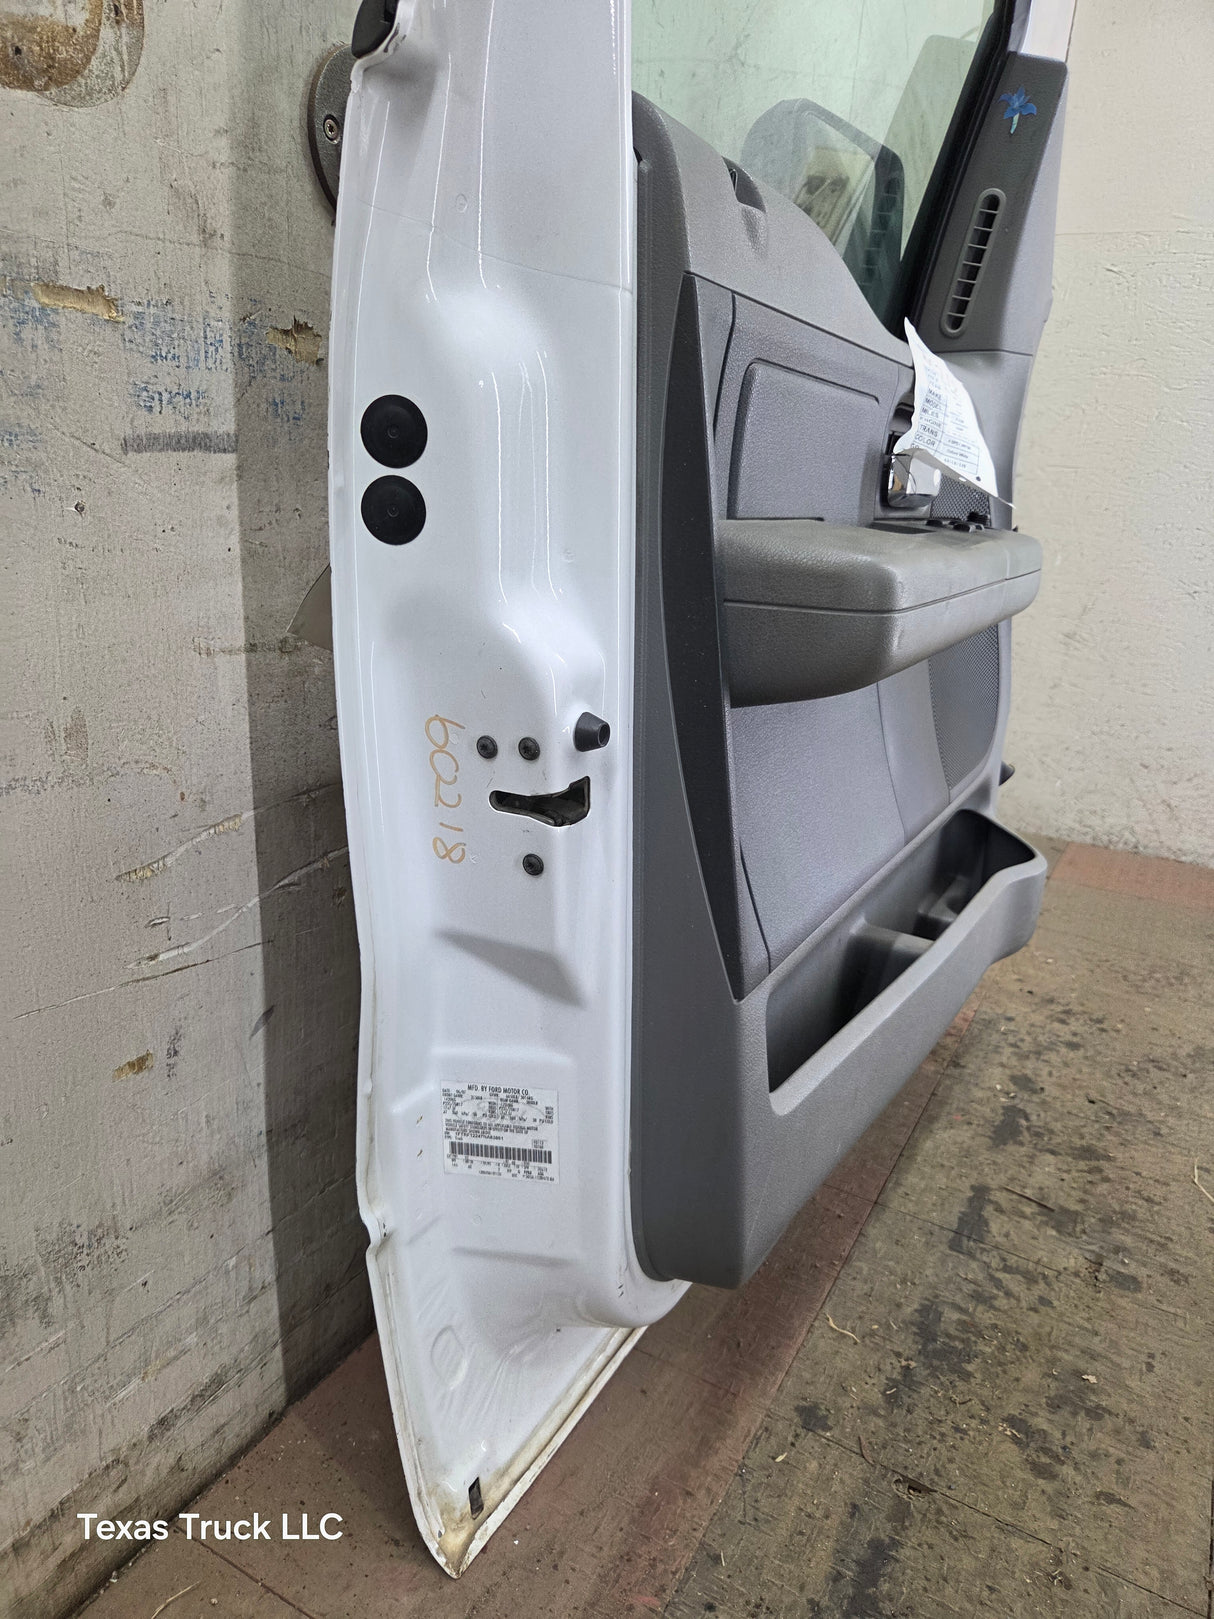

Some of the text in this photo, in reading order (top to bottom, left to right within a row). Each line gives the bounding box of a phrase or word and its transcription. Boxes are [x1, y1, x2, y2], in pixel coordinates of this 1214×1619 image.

[920, 424, 938, 438] TRANS
[914, 433, 936, 447] COLOR
[488, 1085, 502, 1093] FORD
[502, 1086, 520, 1095] MOTOR
